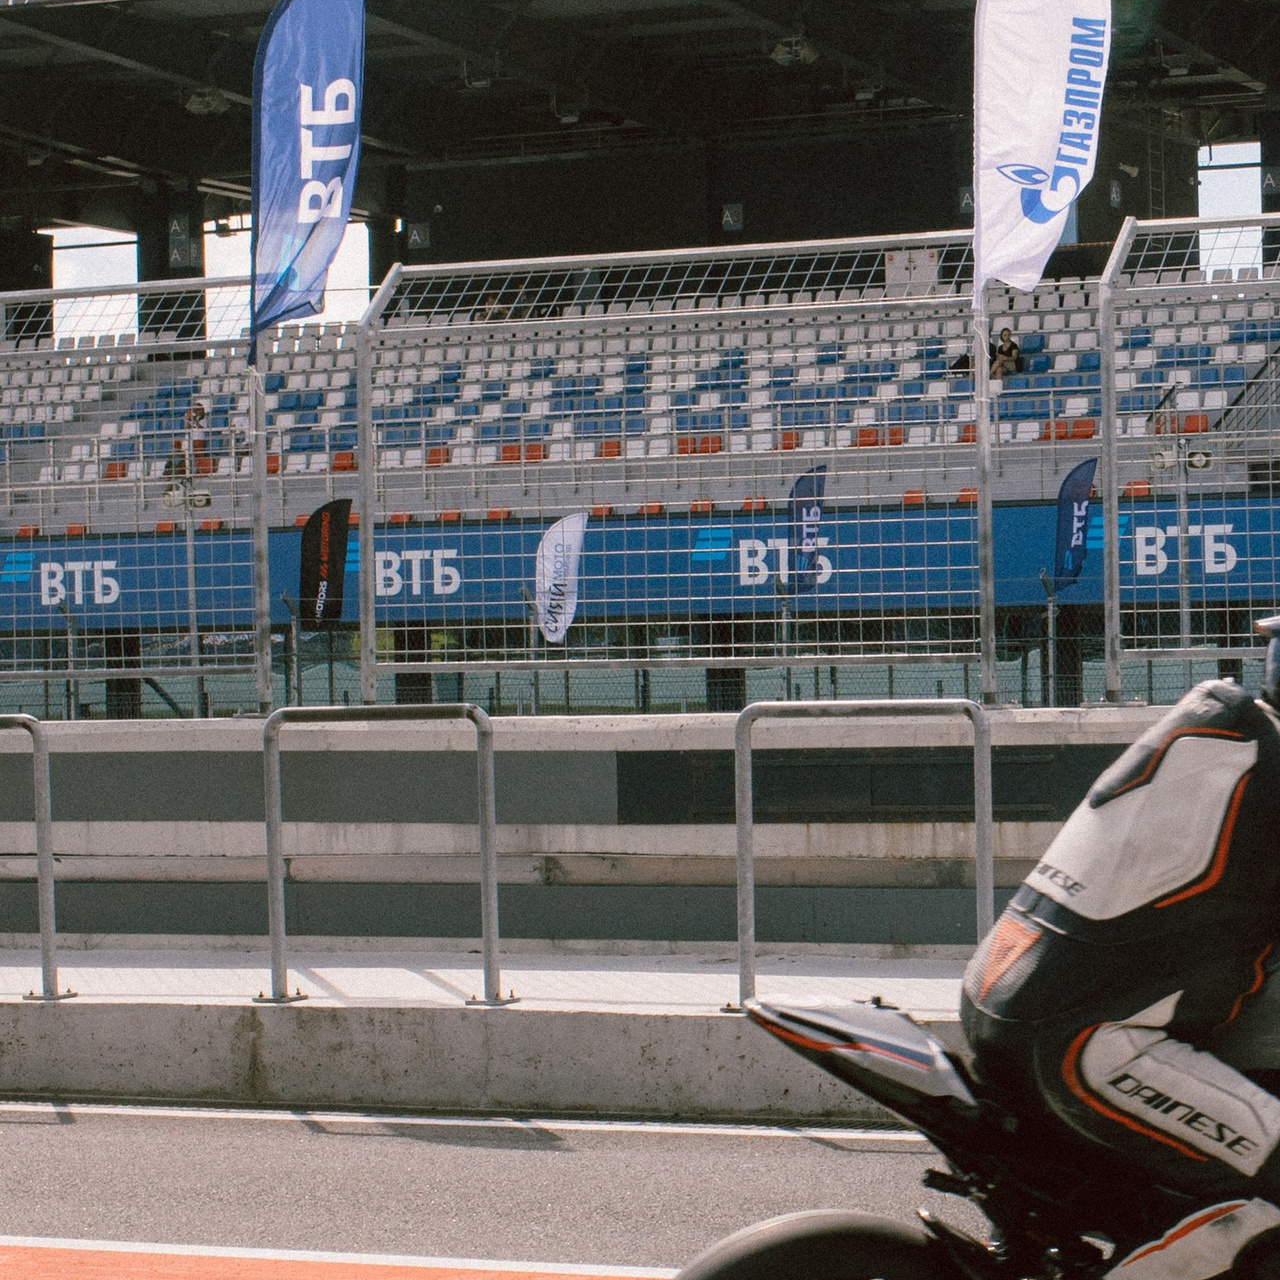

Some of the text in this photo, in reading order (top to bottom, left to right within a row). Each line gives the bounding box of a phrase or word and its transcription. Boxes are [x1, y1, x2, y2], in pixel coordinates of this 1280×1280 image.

[1056, 17, 1107, 165] ГАЗПРОМ
[298, 78, 356, 224] ВТБ
[802, 506, 821, 552] ВТБ
[40, 560, 120, 606] ВТБ
[375, 549, 461, 597] ВТБ
[1107, 1073, 1259, 1156] DAINESE
